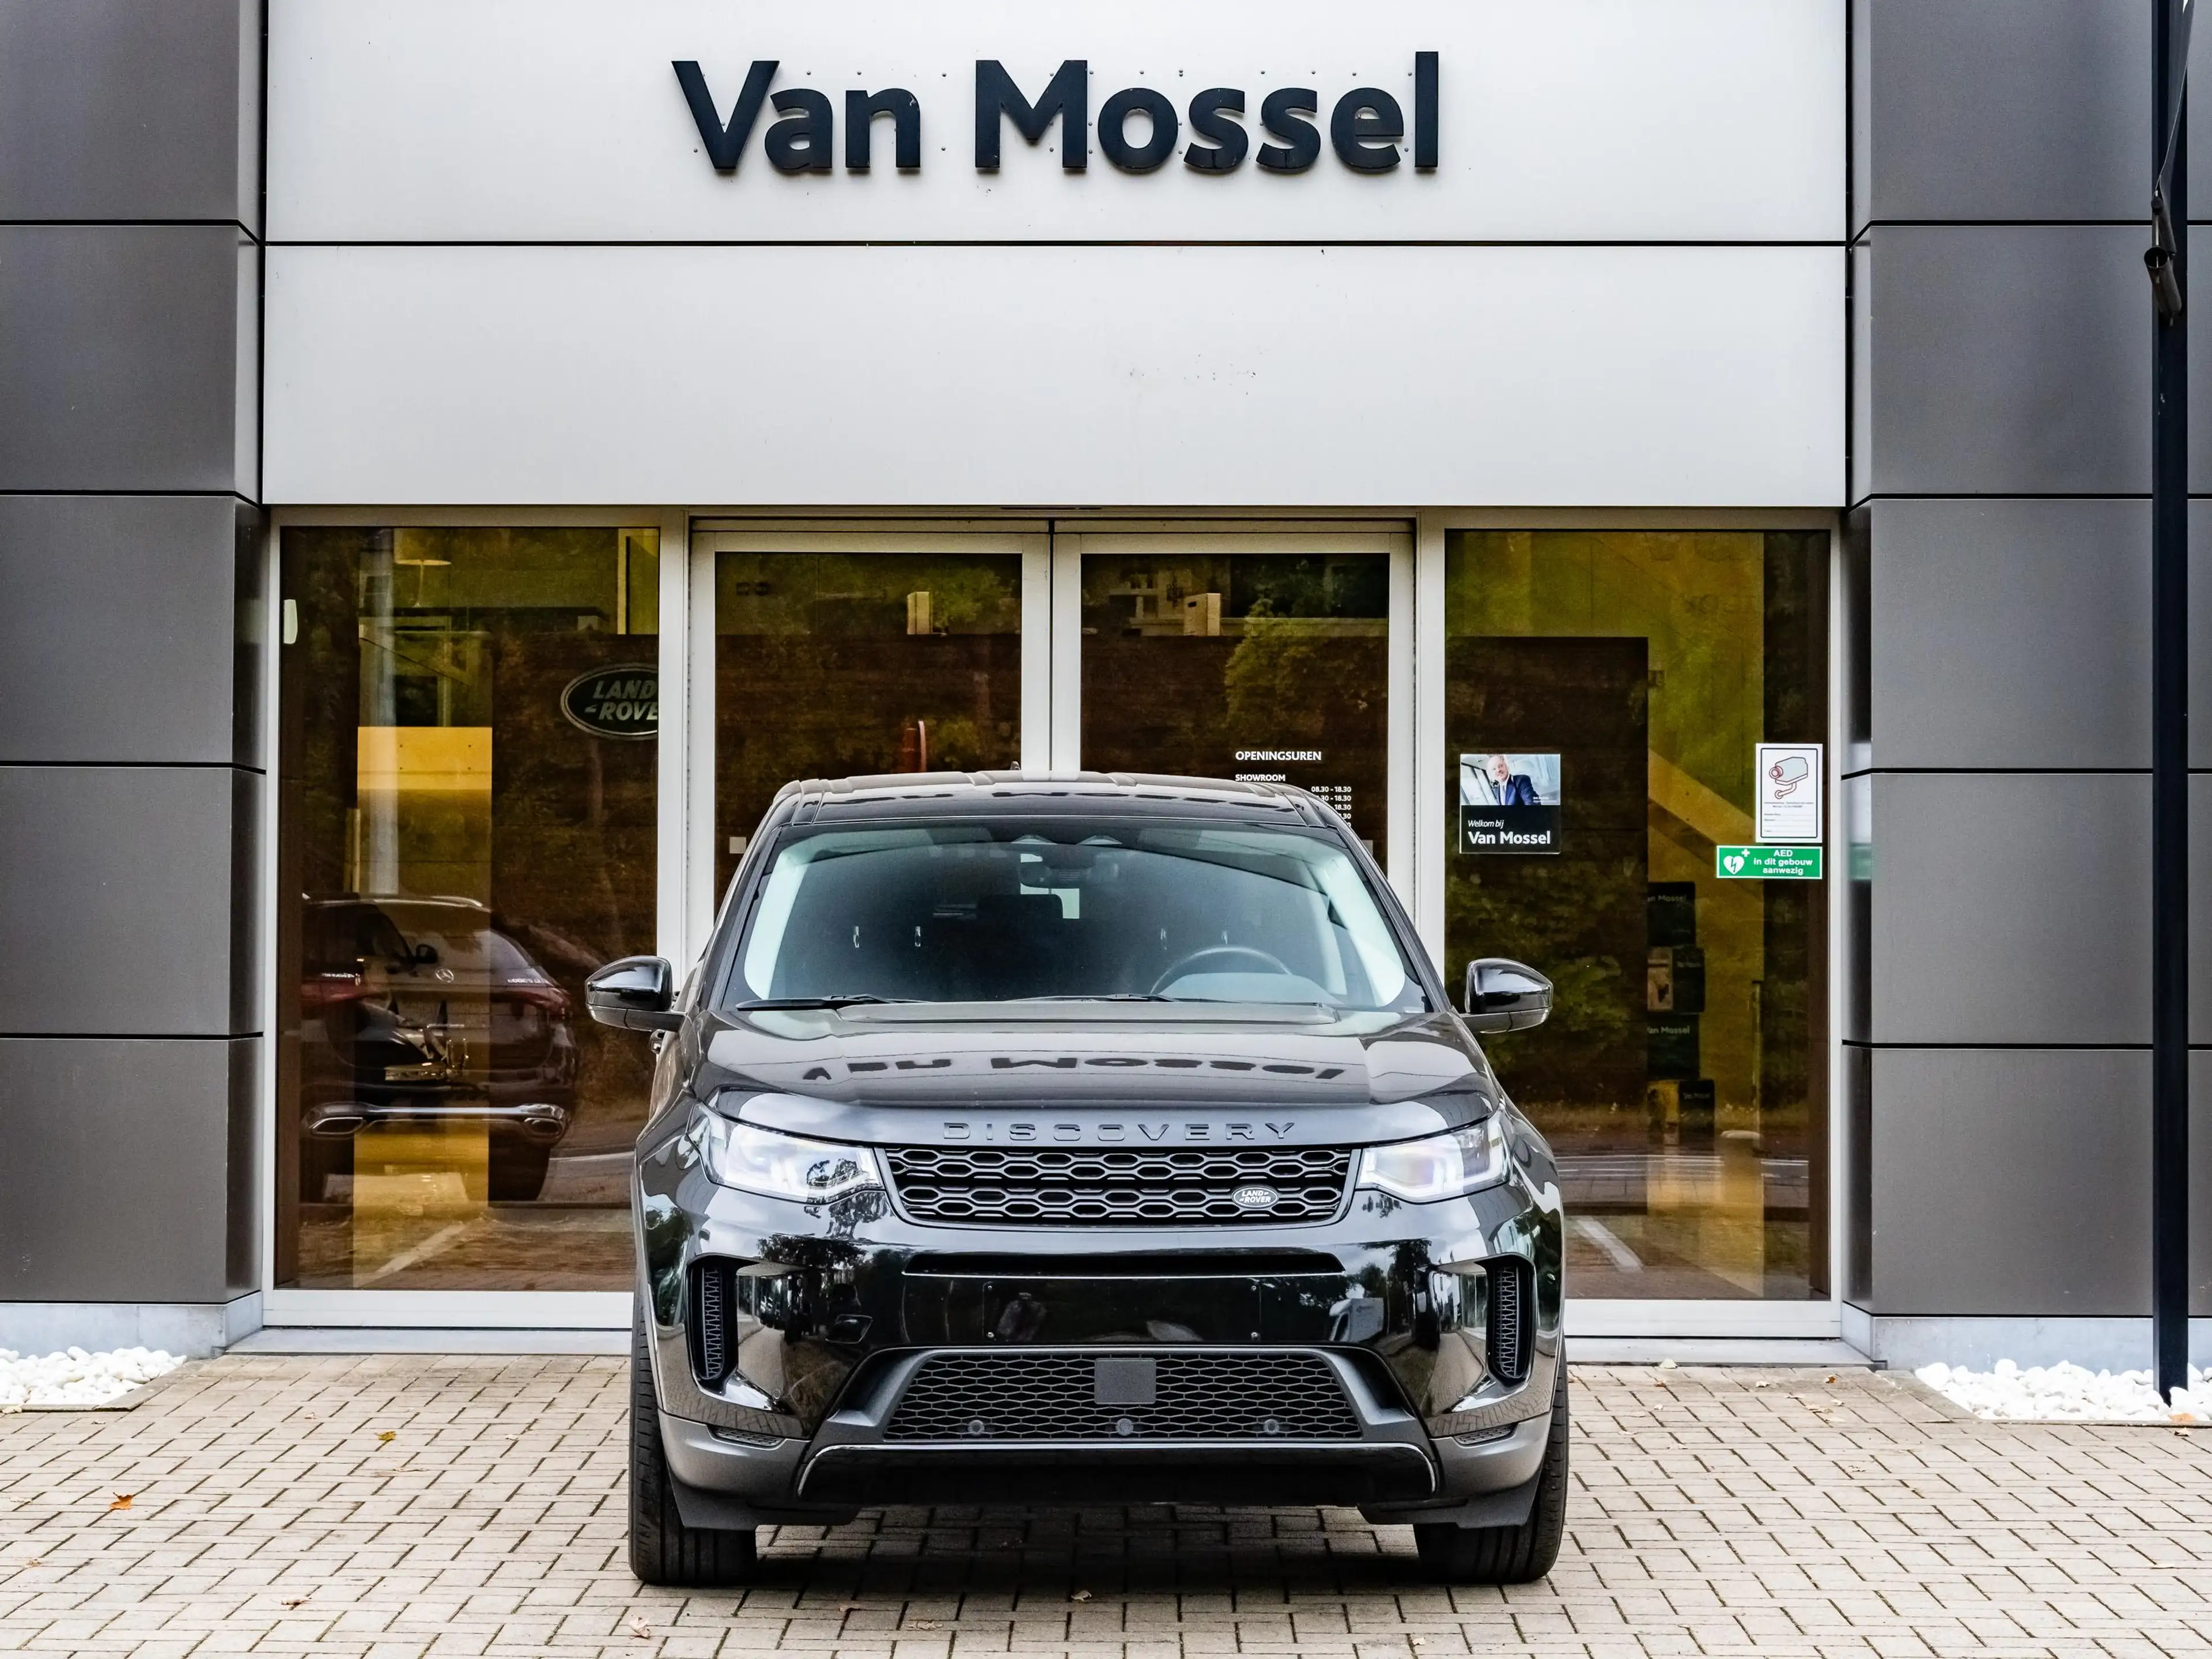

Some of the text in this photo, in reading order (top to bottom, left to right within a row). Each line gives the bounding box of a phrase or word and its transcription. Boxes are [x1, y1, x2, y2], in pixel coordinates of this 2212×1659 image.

[671, 51, 1439, 172] Van Mossel
[592, 680, 657, 699] LAND
[599, 701, 658, 721] ROVE
[1235, 751, 1322, 761] OPENINGSUREN
[1235, 774, 1286, 782] SHOWROOM
[1468, 819, 1504, 829] Welkom bij
[1468, 830, 1551, 844] Van Mossel
[1774, 849, 1793, 857] AED
[1778, 858, 1813, 867] gebouw
[1763, 867, 1804, 876] aanwezig
[943, 1122, 1295, 1141] DISCOVERY
